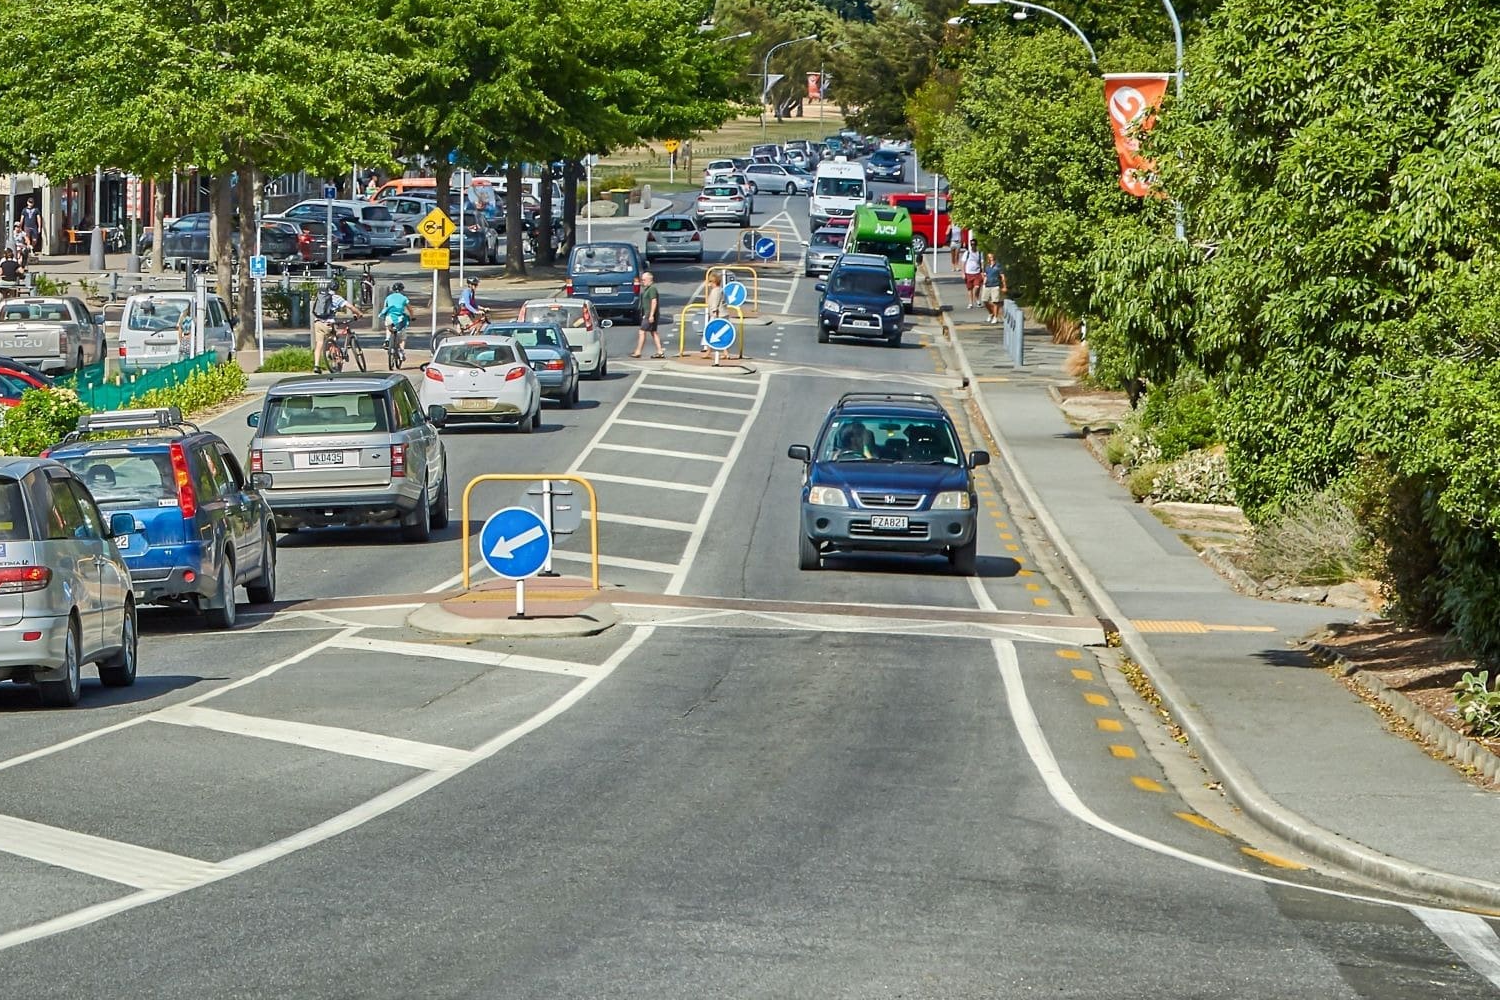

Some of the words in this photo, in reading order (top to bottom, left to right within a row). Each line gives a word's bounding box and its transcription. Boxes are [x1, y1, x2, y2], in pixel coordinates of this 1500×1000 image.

[0, 339, 43, 349] ISUZU
[310, 451, 342, 462] JKD435
[872, 517, 906, 527] FZA821
